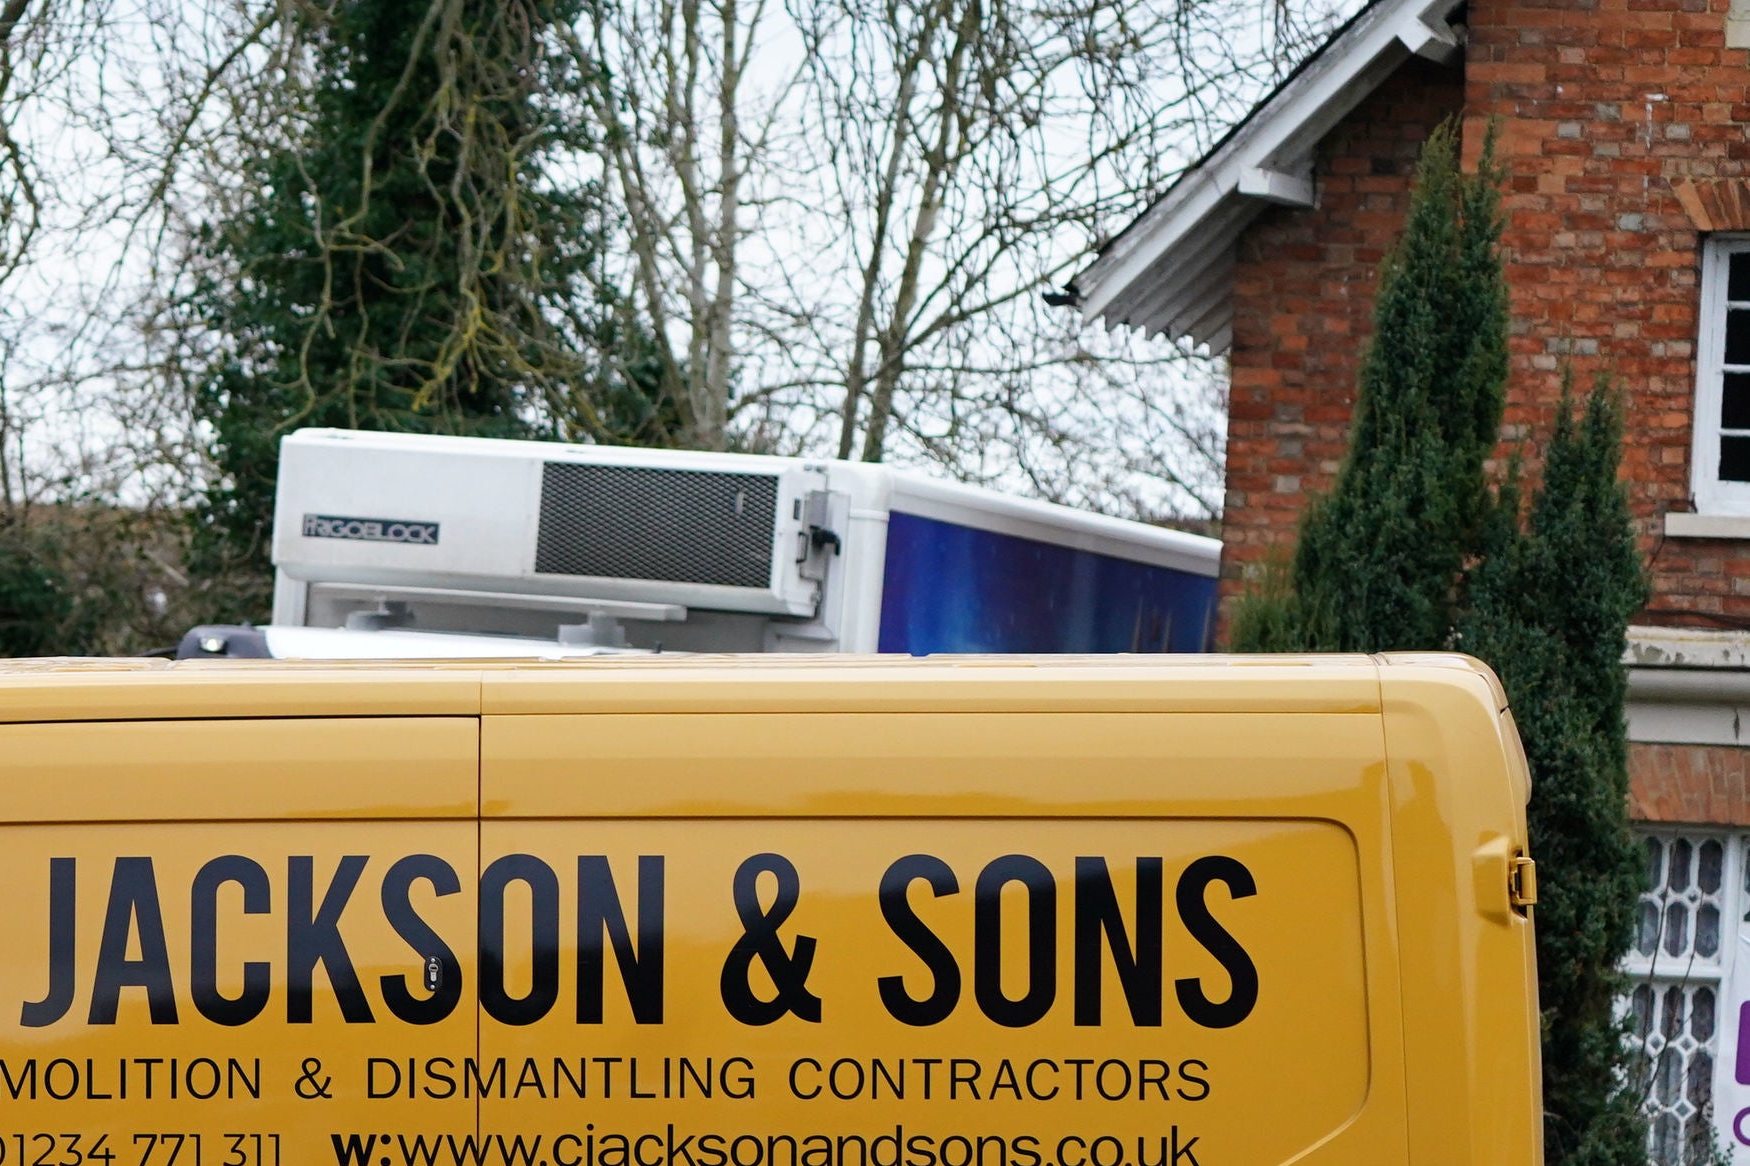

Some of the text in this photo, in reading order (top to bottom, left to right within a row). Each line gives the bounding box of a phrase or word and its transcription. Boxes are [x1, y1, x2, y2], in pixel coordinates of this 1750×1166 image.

[21, 853, 665, 1027] JACKSON
[720, 853, 822, 1027] &
[878, 854, 1259, 1029] SONS
[294, 1057, 333, 1100] &
[367, 1056, 756, 1100] DISMANTLING
[789, 1057, 1210, 1102] CONTRACTORS
